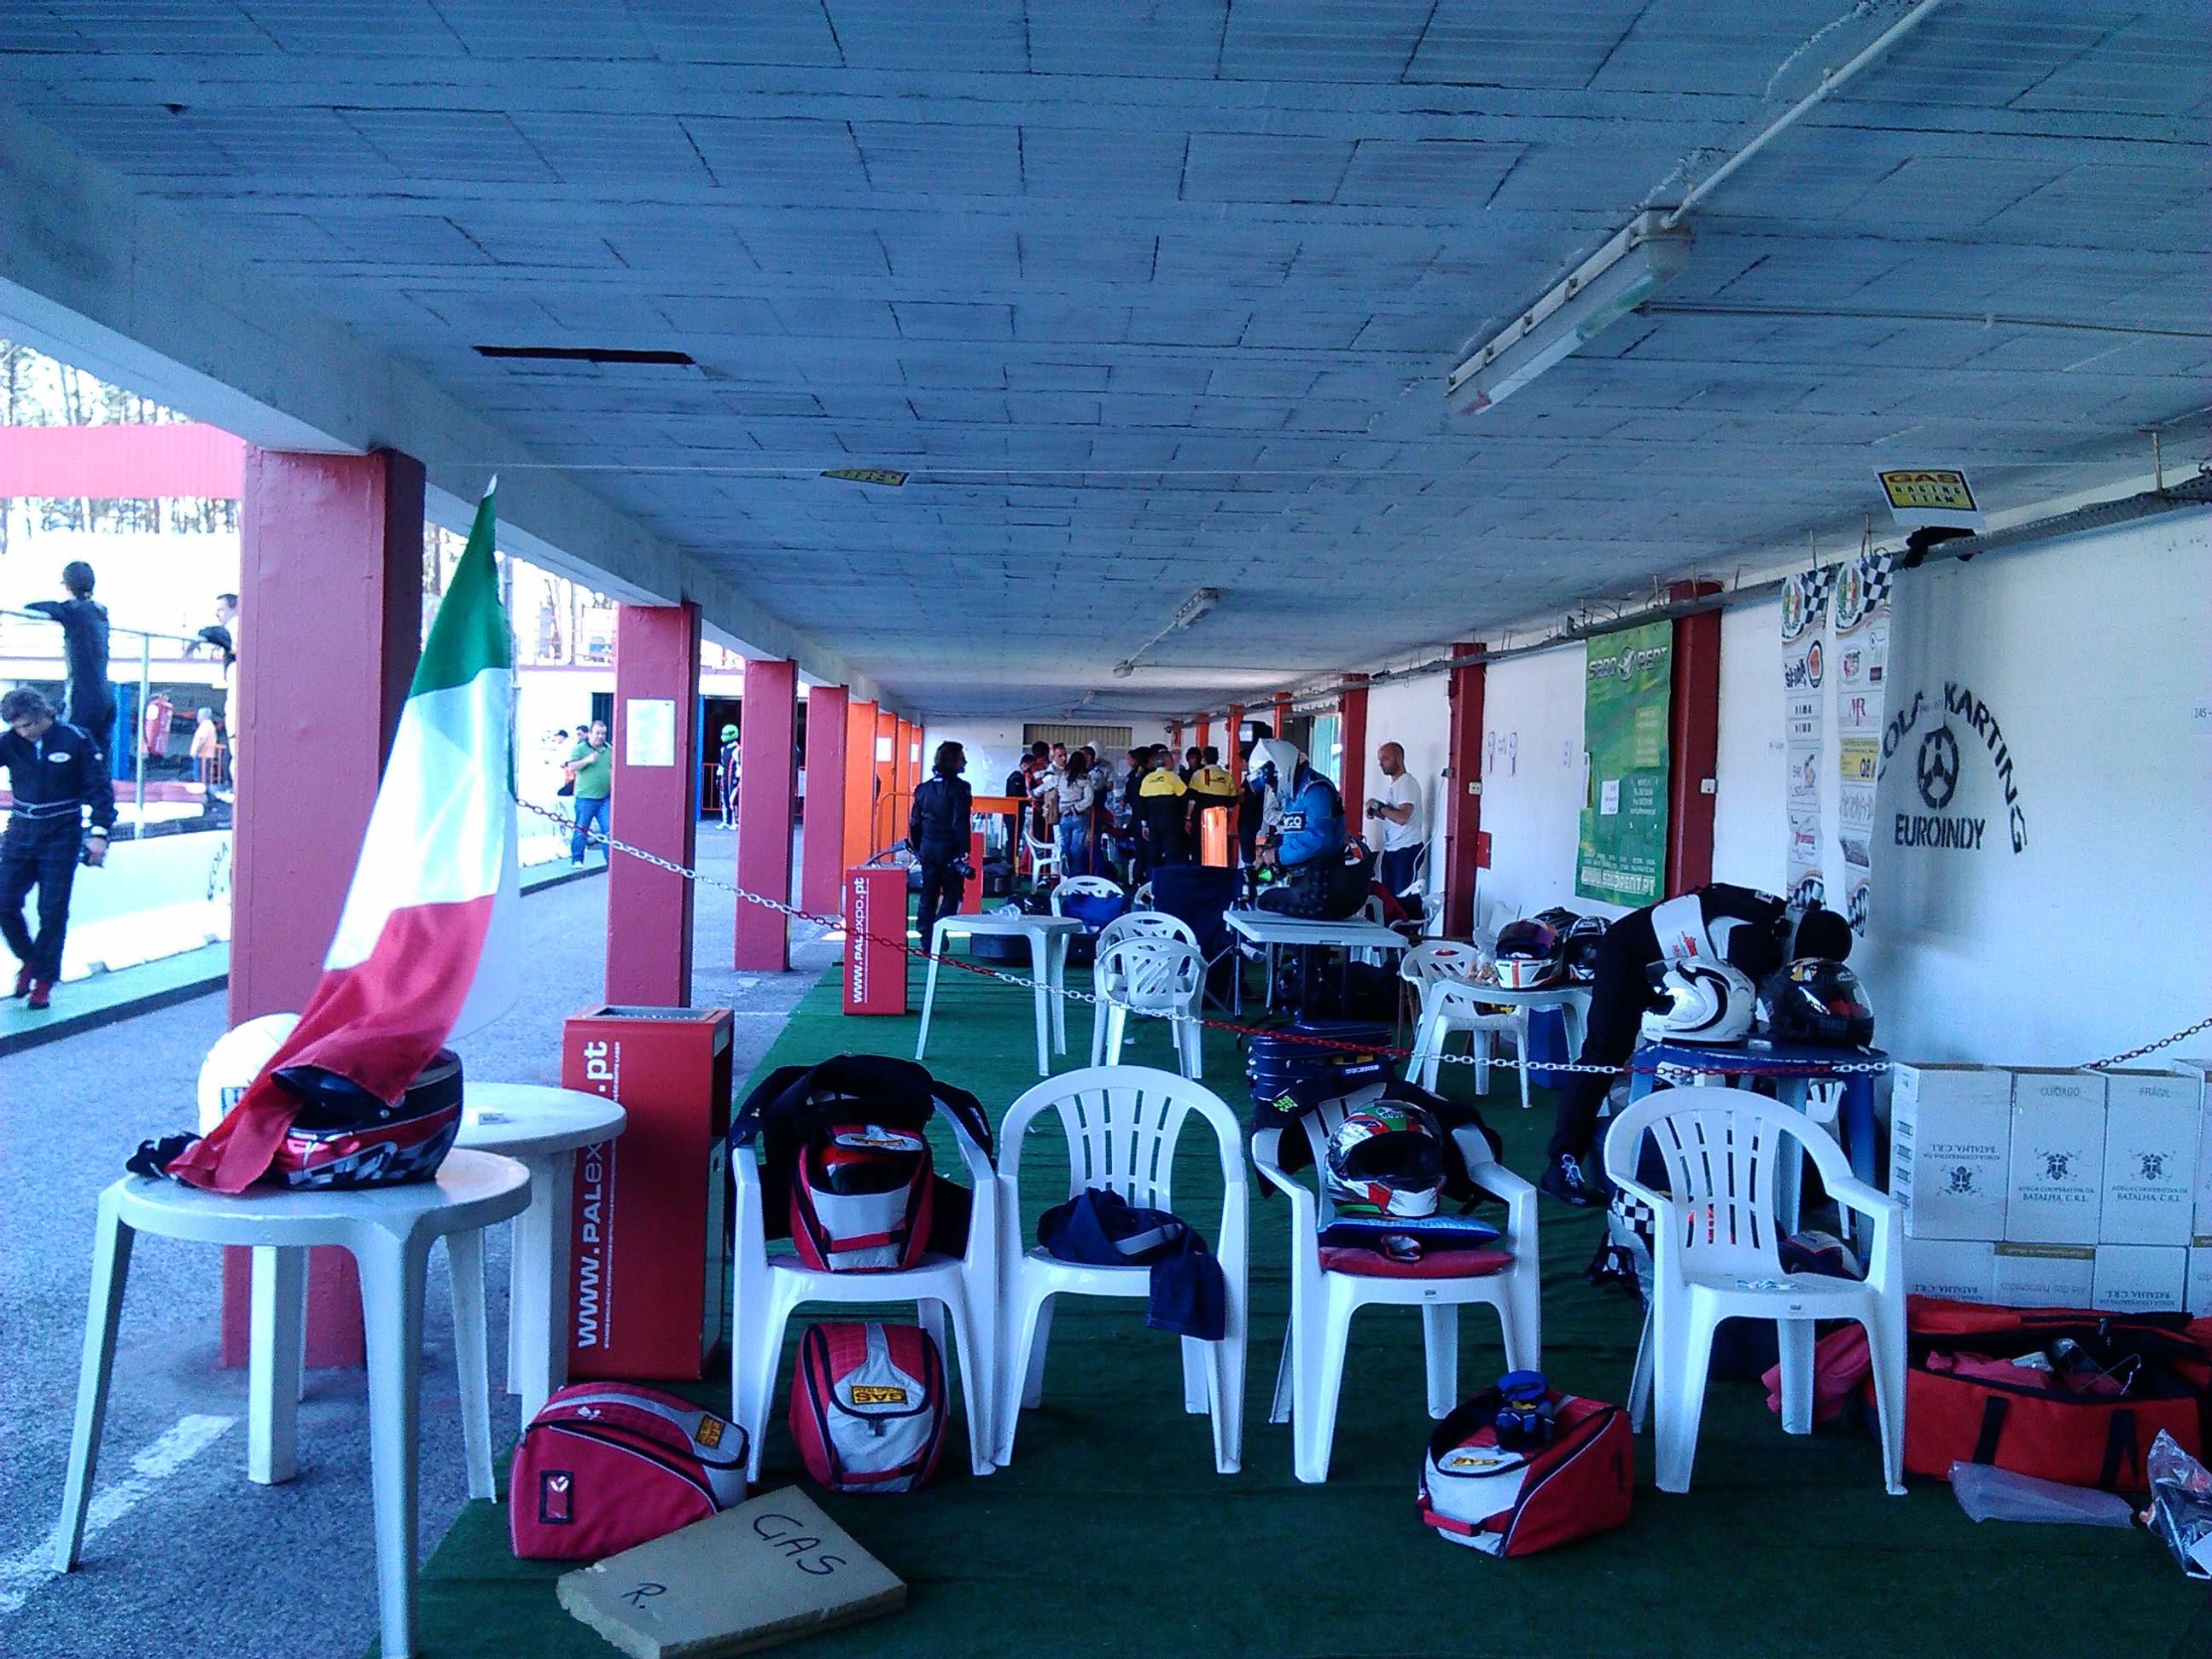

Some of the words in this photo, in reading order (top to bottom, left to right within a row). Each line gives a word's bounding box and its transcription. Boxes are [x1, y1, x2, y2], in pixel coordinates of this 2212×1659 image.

[1942, 682, 2028, 853] KARTING
[1895, 813, 1986, 850] EUROINDY
[855, 1393, 905, 1401] GAS
[754, 1514, 847, 1575] GAS
[620, 1583, 667, 1610] R.
